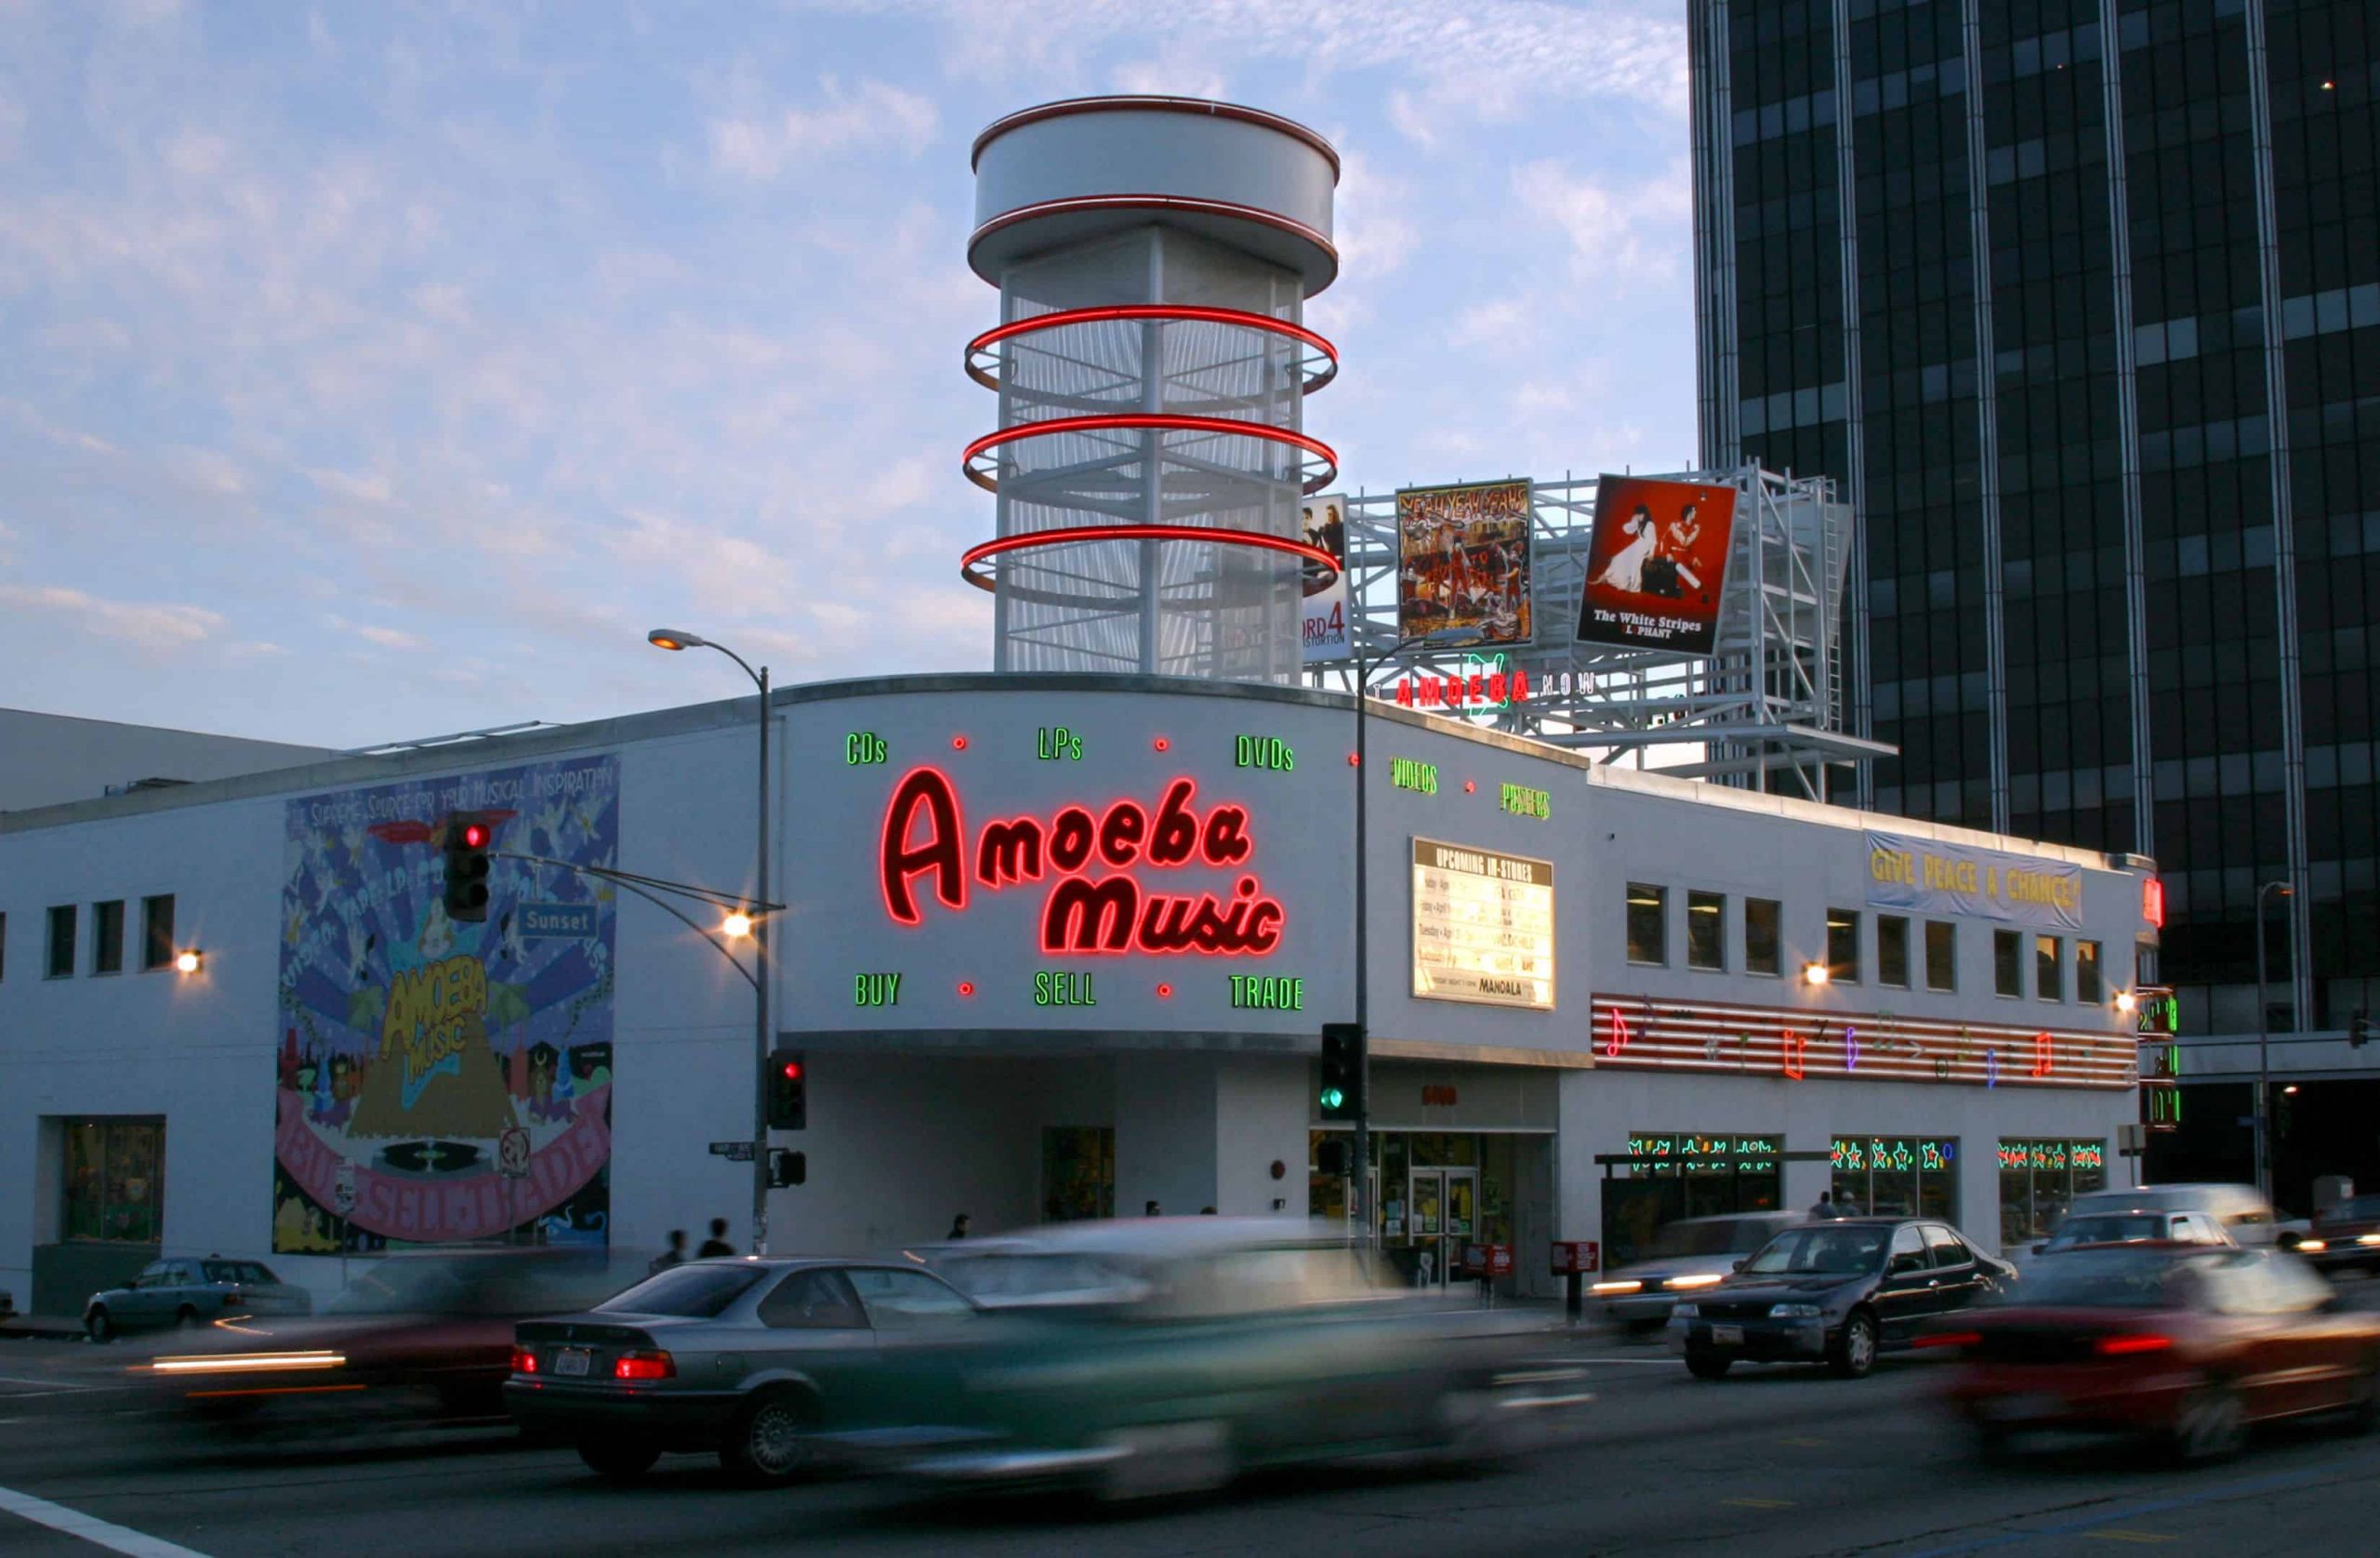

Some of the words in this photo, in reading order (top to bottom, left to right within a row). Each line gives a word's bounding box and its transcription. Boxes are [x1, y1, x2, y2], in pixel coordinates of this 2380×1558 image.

[1402, 497, 1444, 517] YEAH
[1448, 493, 1482, 517] YEAH
[1485, 488, 1527, 513] YEAHS
[1593, 609, 1616, 623] The
[1620, 612, 1656, 627] White
[1658, 617, 1701, 634] Stripes
[1395, 668, 1528, 707] AMOEBA
[1542, 672, 1594, 695] NOW
[846, 732, 887, 764] CDs
[1038, 728, 1082, 760] LPs
[1236, 735, 1294, 771] DVDs
[472, 777, 523, 805] MUSICAL
[1391, 757, 1437, 795] VIDEOS
[1500, 783, 1552, 820] POSTERS
[879, 765, 1251, 926] Amoeba
[1436, 848, 1485, 875] UPCOMING
[1488, 857, 1532, 882] IN-STORES
[1871, 848, 1916, 886] GIVE
[1924, 852, 1978, 893] PEACE
[1987, 865, 1998, 899] A
[526, 910, 589, 930] Sunset
[1041, 875, 1285, 955] Music
[855, 973, 901, 1006] BUY
[1035, 972, 1096, 1005] SELL
[1230, 974, 1303, 1010] TRADE
[1479, 978, 1522, 997] MANDALA
[379, 955, 488, 1062] AMOEBA
[409, 1015, 467, 1086] MUSIC
